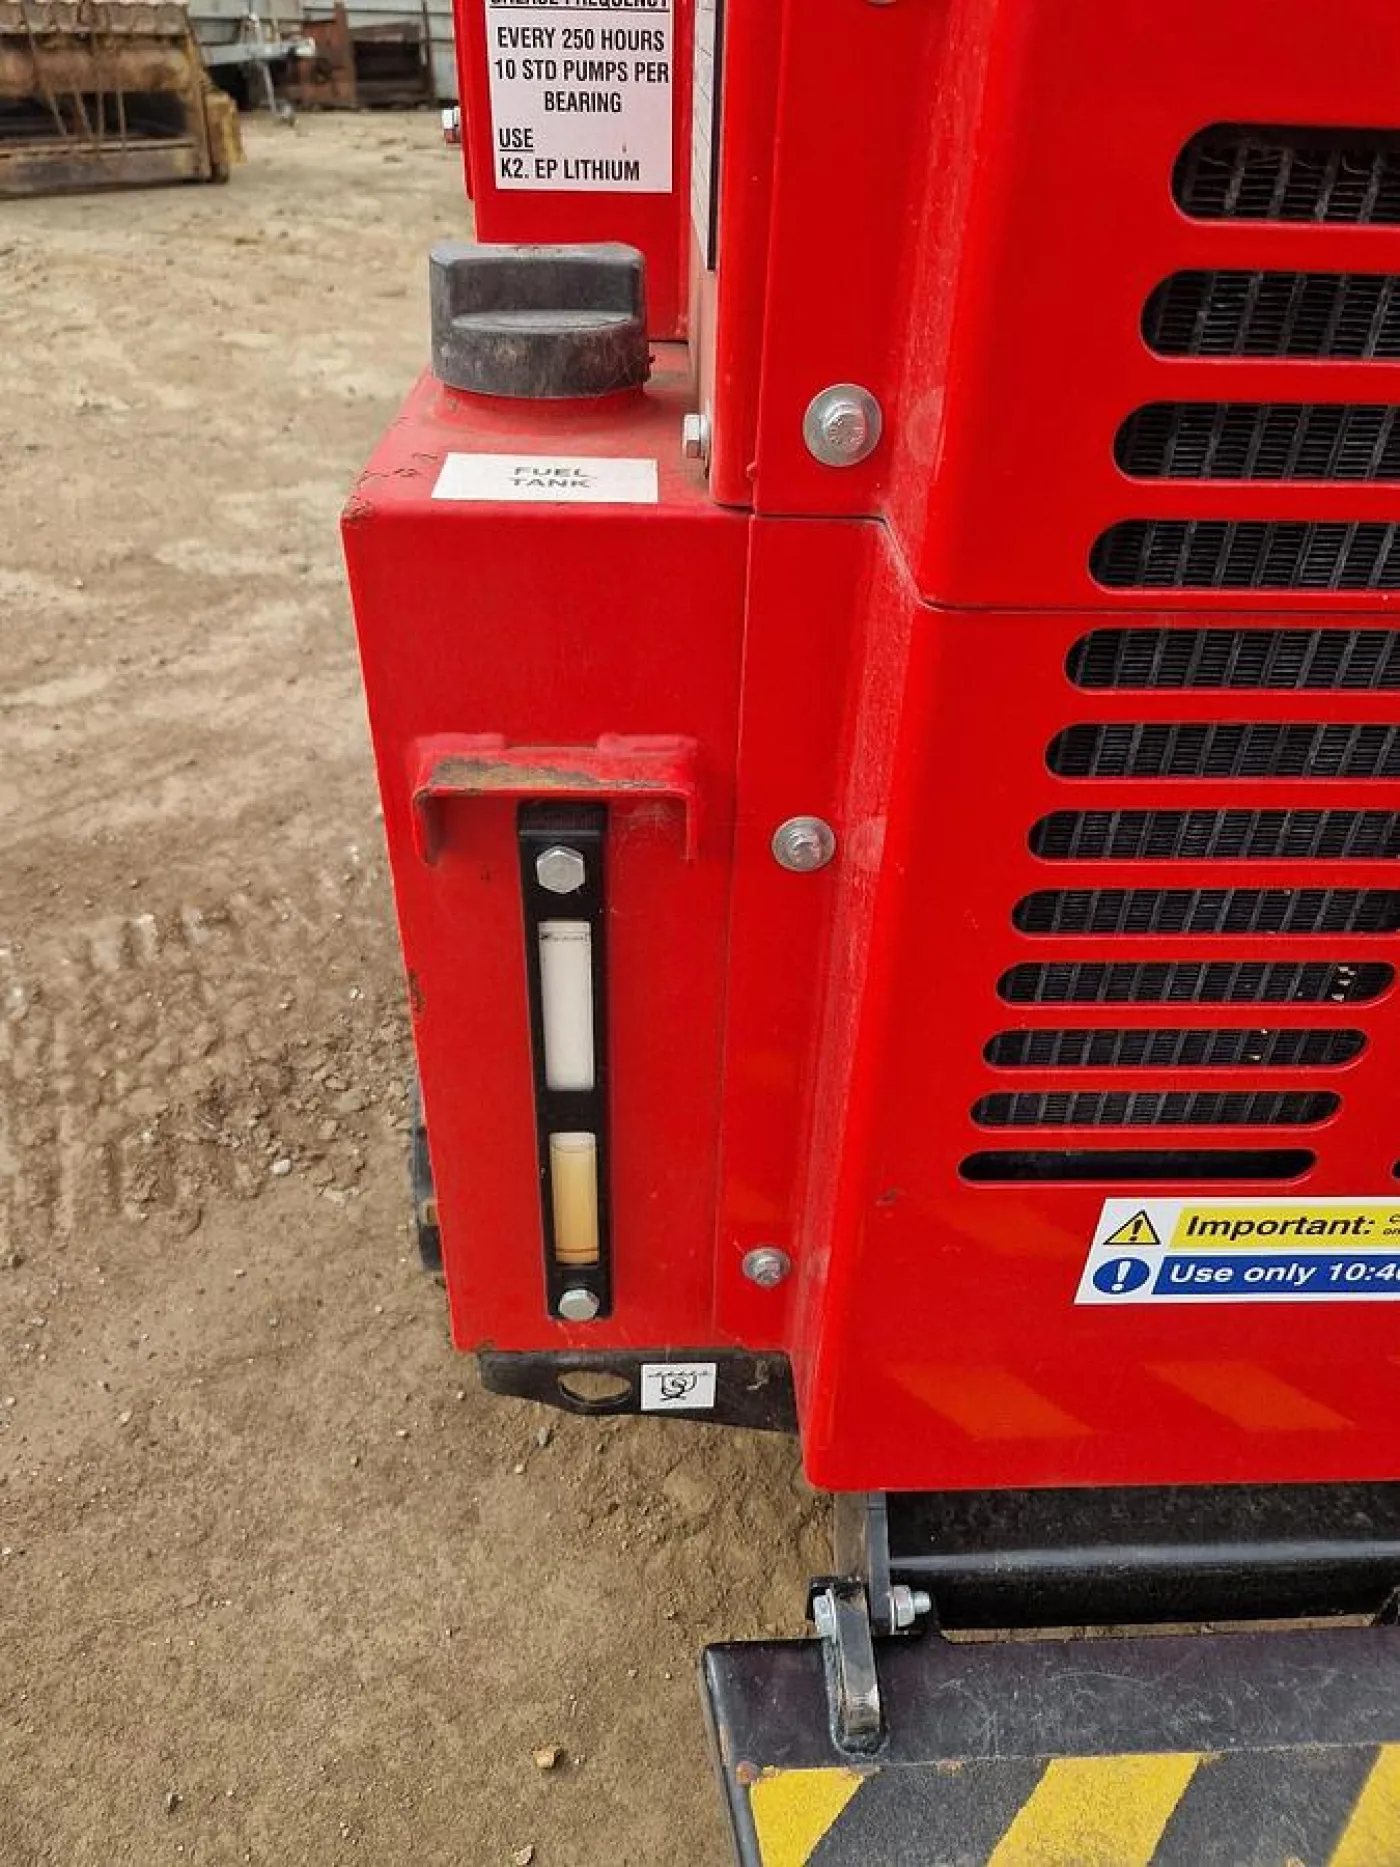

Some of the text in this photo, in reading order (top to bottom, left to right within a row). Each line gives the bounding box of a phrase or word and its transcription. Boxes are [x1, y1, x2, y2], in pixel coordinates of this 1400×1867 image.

[497, 27, 665, 51] EVERY 250 HOURS
[494, 59, 669, 83] 10 STD PUMPS PER
[544, 91, 622, 113] BEARING
[499, 128, 534, 149] USE
[501, 158, 640, 181] K2. EP LITHIUM
[509, 477, 592, 489] TANK
[513, 466, 591, 478] FUEL
[1186, 1215, 1375, 1241] Important:
[1170, 1263, 1400, 1286] Use only 10:4
